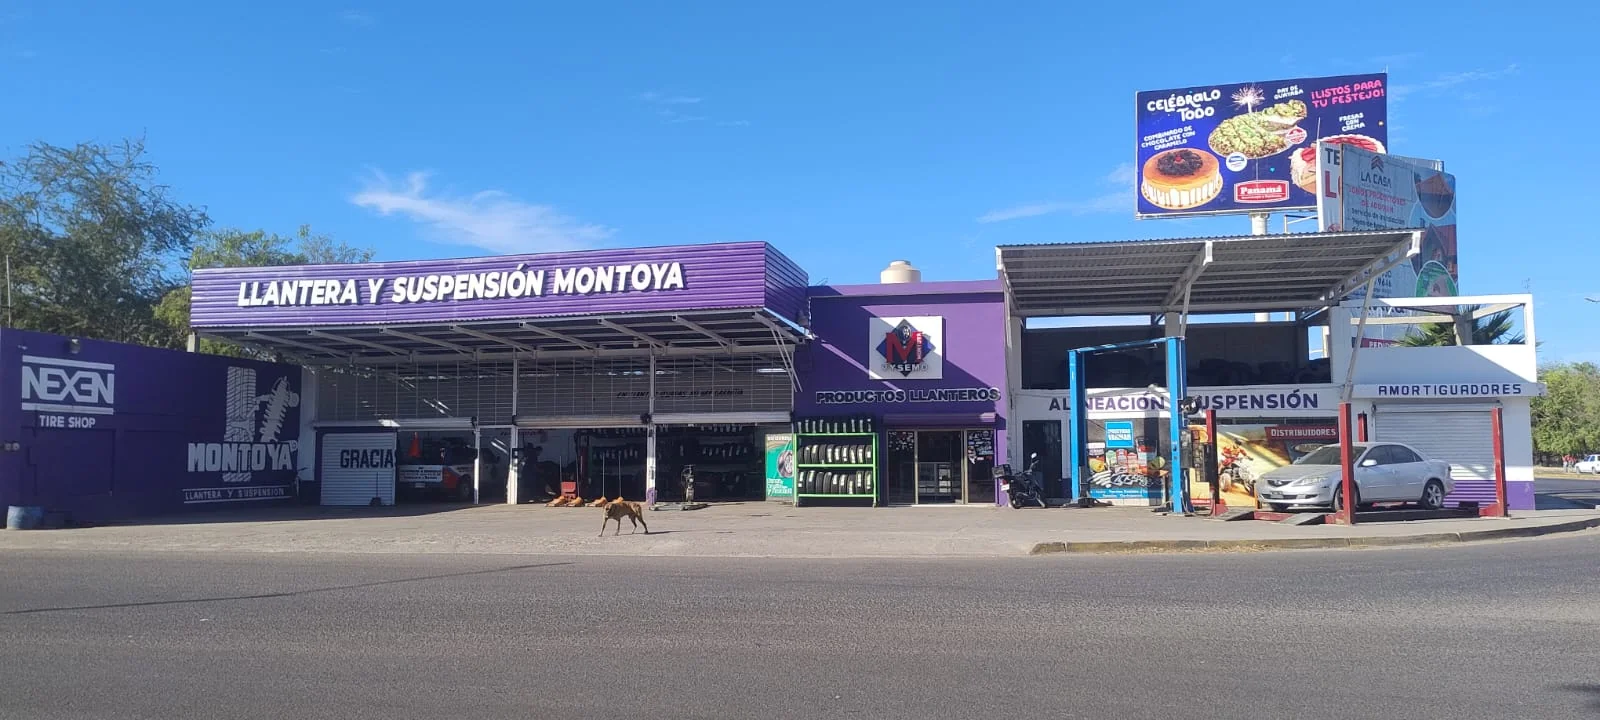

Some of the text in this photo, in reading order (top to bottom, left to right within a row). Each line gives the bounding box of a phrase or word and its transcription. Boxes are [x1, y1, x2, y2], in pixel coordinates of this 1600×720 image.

[1311, 80, 1382, 100] ¡LISTOS PARA
[1312, 89, 1384, 108] TU FESTEJO!
[1147, 89, 1221, 112] CELÉBRALO
[1176, 106, 1215, 122] TODO
[1339, 112, 1364, 121] FRESAS
[1342, 122, 1365, 132] CREMA
[1141, 130, 1196, 148] CHOCOLATE CON
[1325, 170, 1340, 198] L
[1361, 171, 1371, 183] LA
[1373, 174, 1392, 188] CASA
[1240, 185, 1282, 194] Panamá
[238, 262, 684, 308] LLANTERA Y SUSPENSIÓN MONTOYA
[21, 365, 115, 404] NEXEN
[1378, 383, 1522, 396] AMORTIGUADORES
[816, 387, 1001, 404] PRODUCTOS LLANTEROS
[1048, 389, 1318, 411] ALNEACIÓN USPENSIÓN
[40, 415, 96, 428] TIRE SHOP
[187, 442, 293, 472] MONTOYA
[340, 449, 397, 468] GRACIA
[185, 490, 222, 501] LLANTERA
[227, 490, 234, 498] Y
